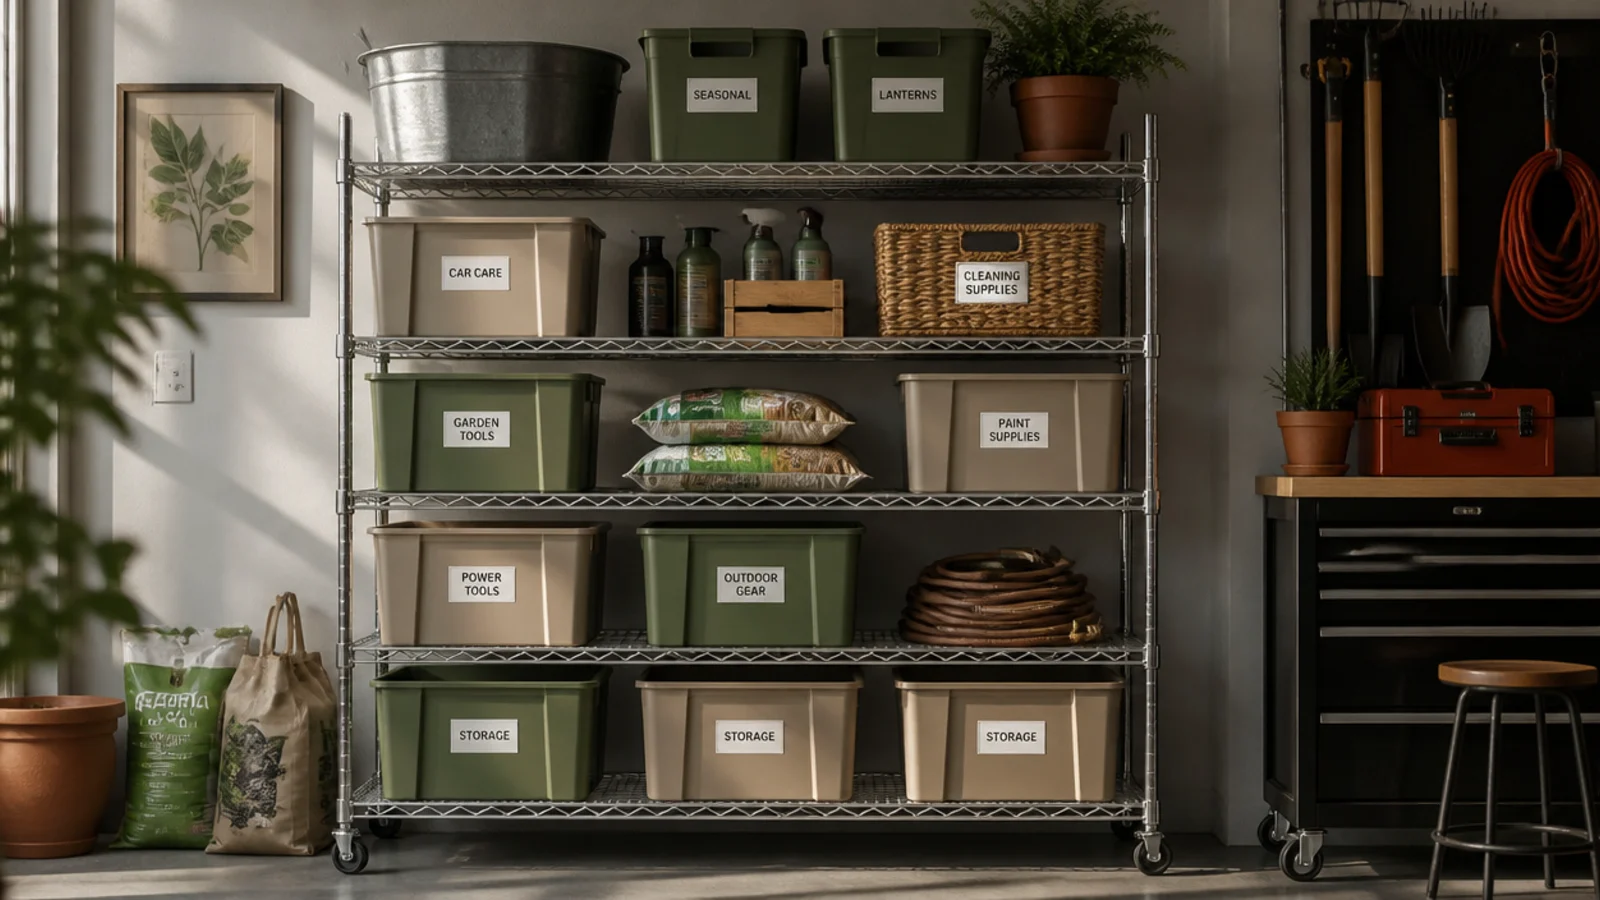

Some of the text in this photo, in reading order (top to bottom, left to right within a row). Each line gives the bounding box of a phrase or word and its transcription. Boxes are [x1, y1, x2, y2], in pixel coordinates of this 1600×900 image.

[693, 90, 752, 100] SEASONAL
[879, 90, 938, 100] LANTERNS
[449, 268, 504, 278] CAR CARE
[964, 271, 1021, 281] CLEANING
[965, 284, 1019, 295] SUPPLIES
[453, 417, 499, 427] GARDEN
[998, 418, 1031, 428] PAINT
[459, 430, 495, 440] TOOLS
[989, 431, 1040, 441] SUPPLIES
[461, 572, 502, 582] POWER
[723, 572, 778, 582] OUTDOOR
[464, 586, 500, 596] TOOLS
[735, 586, 766, 596] GEAR
[459, 730, 510, 741] STORAGE
[724, 731, 776, 742] STORAGE
[986, 731, 1037, 742] STORAGE
